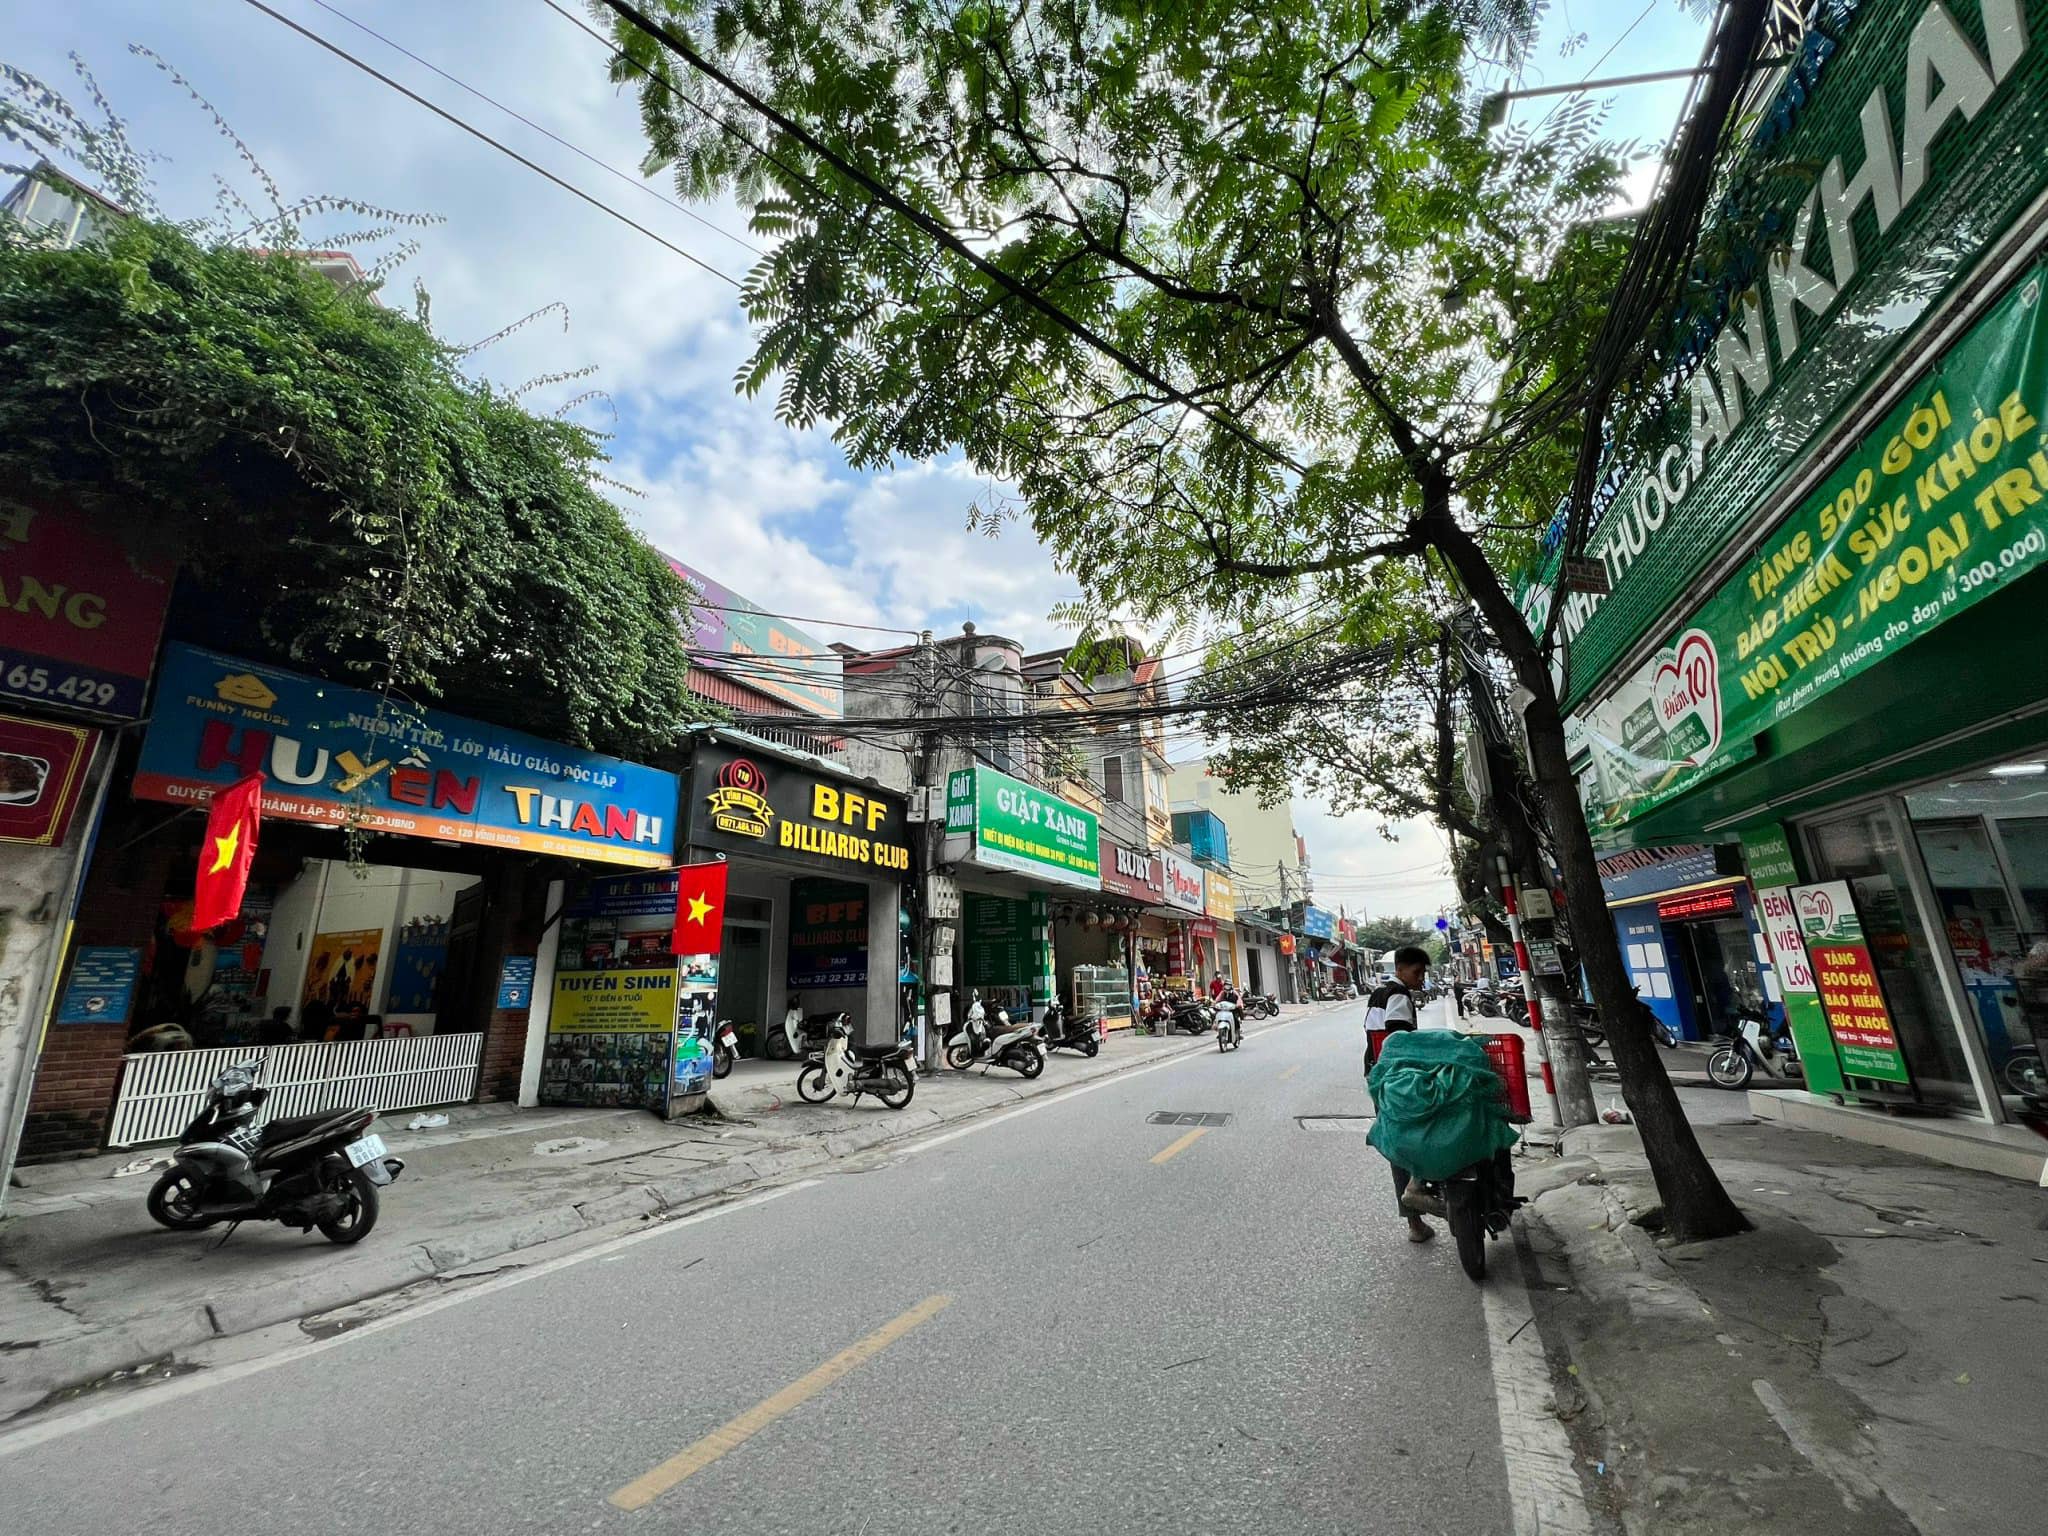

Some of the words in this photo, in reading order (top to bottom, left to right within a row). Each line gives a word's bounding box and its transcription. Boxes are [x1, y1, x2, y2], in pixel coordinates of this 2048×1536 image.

[1749, 529, 1813, 601] TẶNG
[1820, 468, 1875, 542] 500
[1881, 391, 1953, 476] GÓI
[1737, 612, 1779, 661] BẢO
[1782, 553, 1854, 624] HIỂM
[1848, 493, 1913, 566] SỨC
[1914, 390, 2038, 512] KHỎE
[1884, 620, 1910, 644] cho
[1911, 602, 1940, 628] đơn
[1958, 528, 2047, 594] 300.000)
[1739, 654, 1788, 700] NỘI
[1858, 518, 1971, 622] NGOẠI
[0, 660, 117, 706] 65.429
[1685, 656, 1707, 706] 10
[186, 695, 237, 715] FUNNY
[241, 710, 290, 727] HOUSE
[196, 717, 481, 815] HUYỀN
[452, 736, 485, 756] LỚP
[487, 743, 522, 768] MẪU
[524, 755, 561, 777] GIÁO
[592, 770, 617, 789] LẬP
[813, 783, 888, 832] BFF
[951, 773, 971, 803] GIẶT
[504, 785, 663, 846] THANH
[949, 804, 973, 828] XANH
[997, 788, 1041, 826] GIẶT
[1044, 805, 1088, 842] XANH
[779, 819, 870, 864] BILLIARDS
[873, 842, 909, 871] CLUB
[1116, 846, 1151, 882] RUBY
[1609, 846, 1657, 874] DENTAL
[806, 901, 865, 925] BFF
[1817, 900, 1830, 916] 10
[1822, 971, 1849, 987] 500
[1850, 970, 1873, 987] GÓI
[1823, 948, 1856, 970] TẶNG
[559, 972, 617, 992] TUYỂN
[623, 975, 672, 990] SINH
[1824, 989, 1849, 1008] BẢO
[1852, 990, 1883, 1009] HIỂM
[1831, 1010, 1853, 1027] SỨC
[1855, 1012, 1889, 1031] KHỎE
